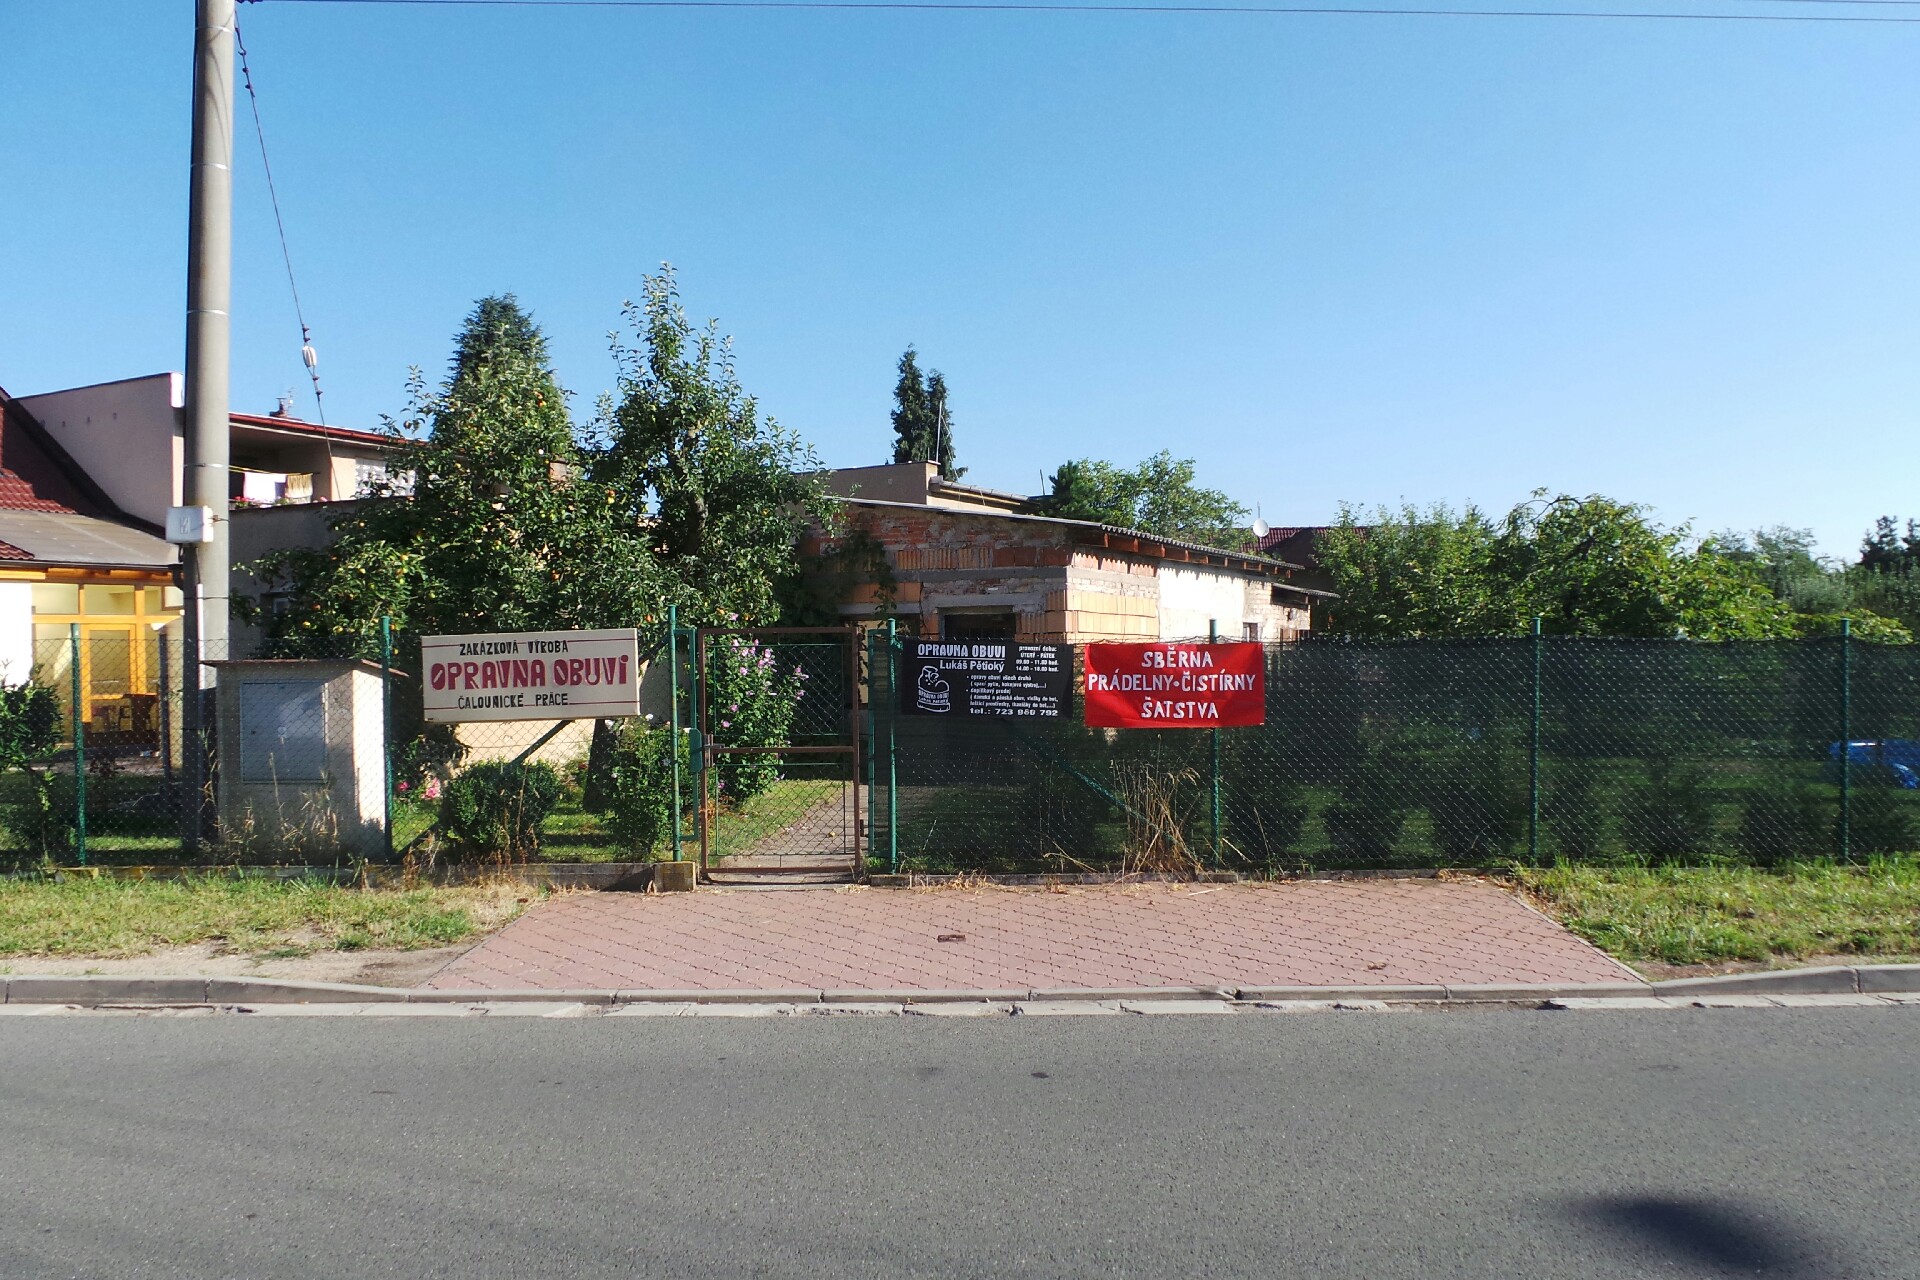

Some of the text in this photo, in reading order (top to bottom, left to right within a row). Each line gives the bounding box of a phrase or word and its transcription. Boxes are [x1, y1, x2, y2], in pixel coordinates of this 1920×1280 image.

[459, 639, 569, 656] ZAKÁZKOVÁ VÝROBA
[917, 643, 1006, 658] OPRAVNA OBUVI
[940, 659, 968, 670] Lukáš
[1141, 646, 1214, 669] SBĚRNA
[430, 659, 546, 691] OPRAVNA
[535, 692, 569, 706] PRÁCE
[969, 707, 991, 715] tel.:
[994, 708, 1014, 716] 723
[1039, 709, 1059, 717] 792
[1141, 696, 1219, 719] ŠATSTVA
